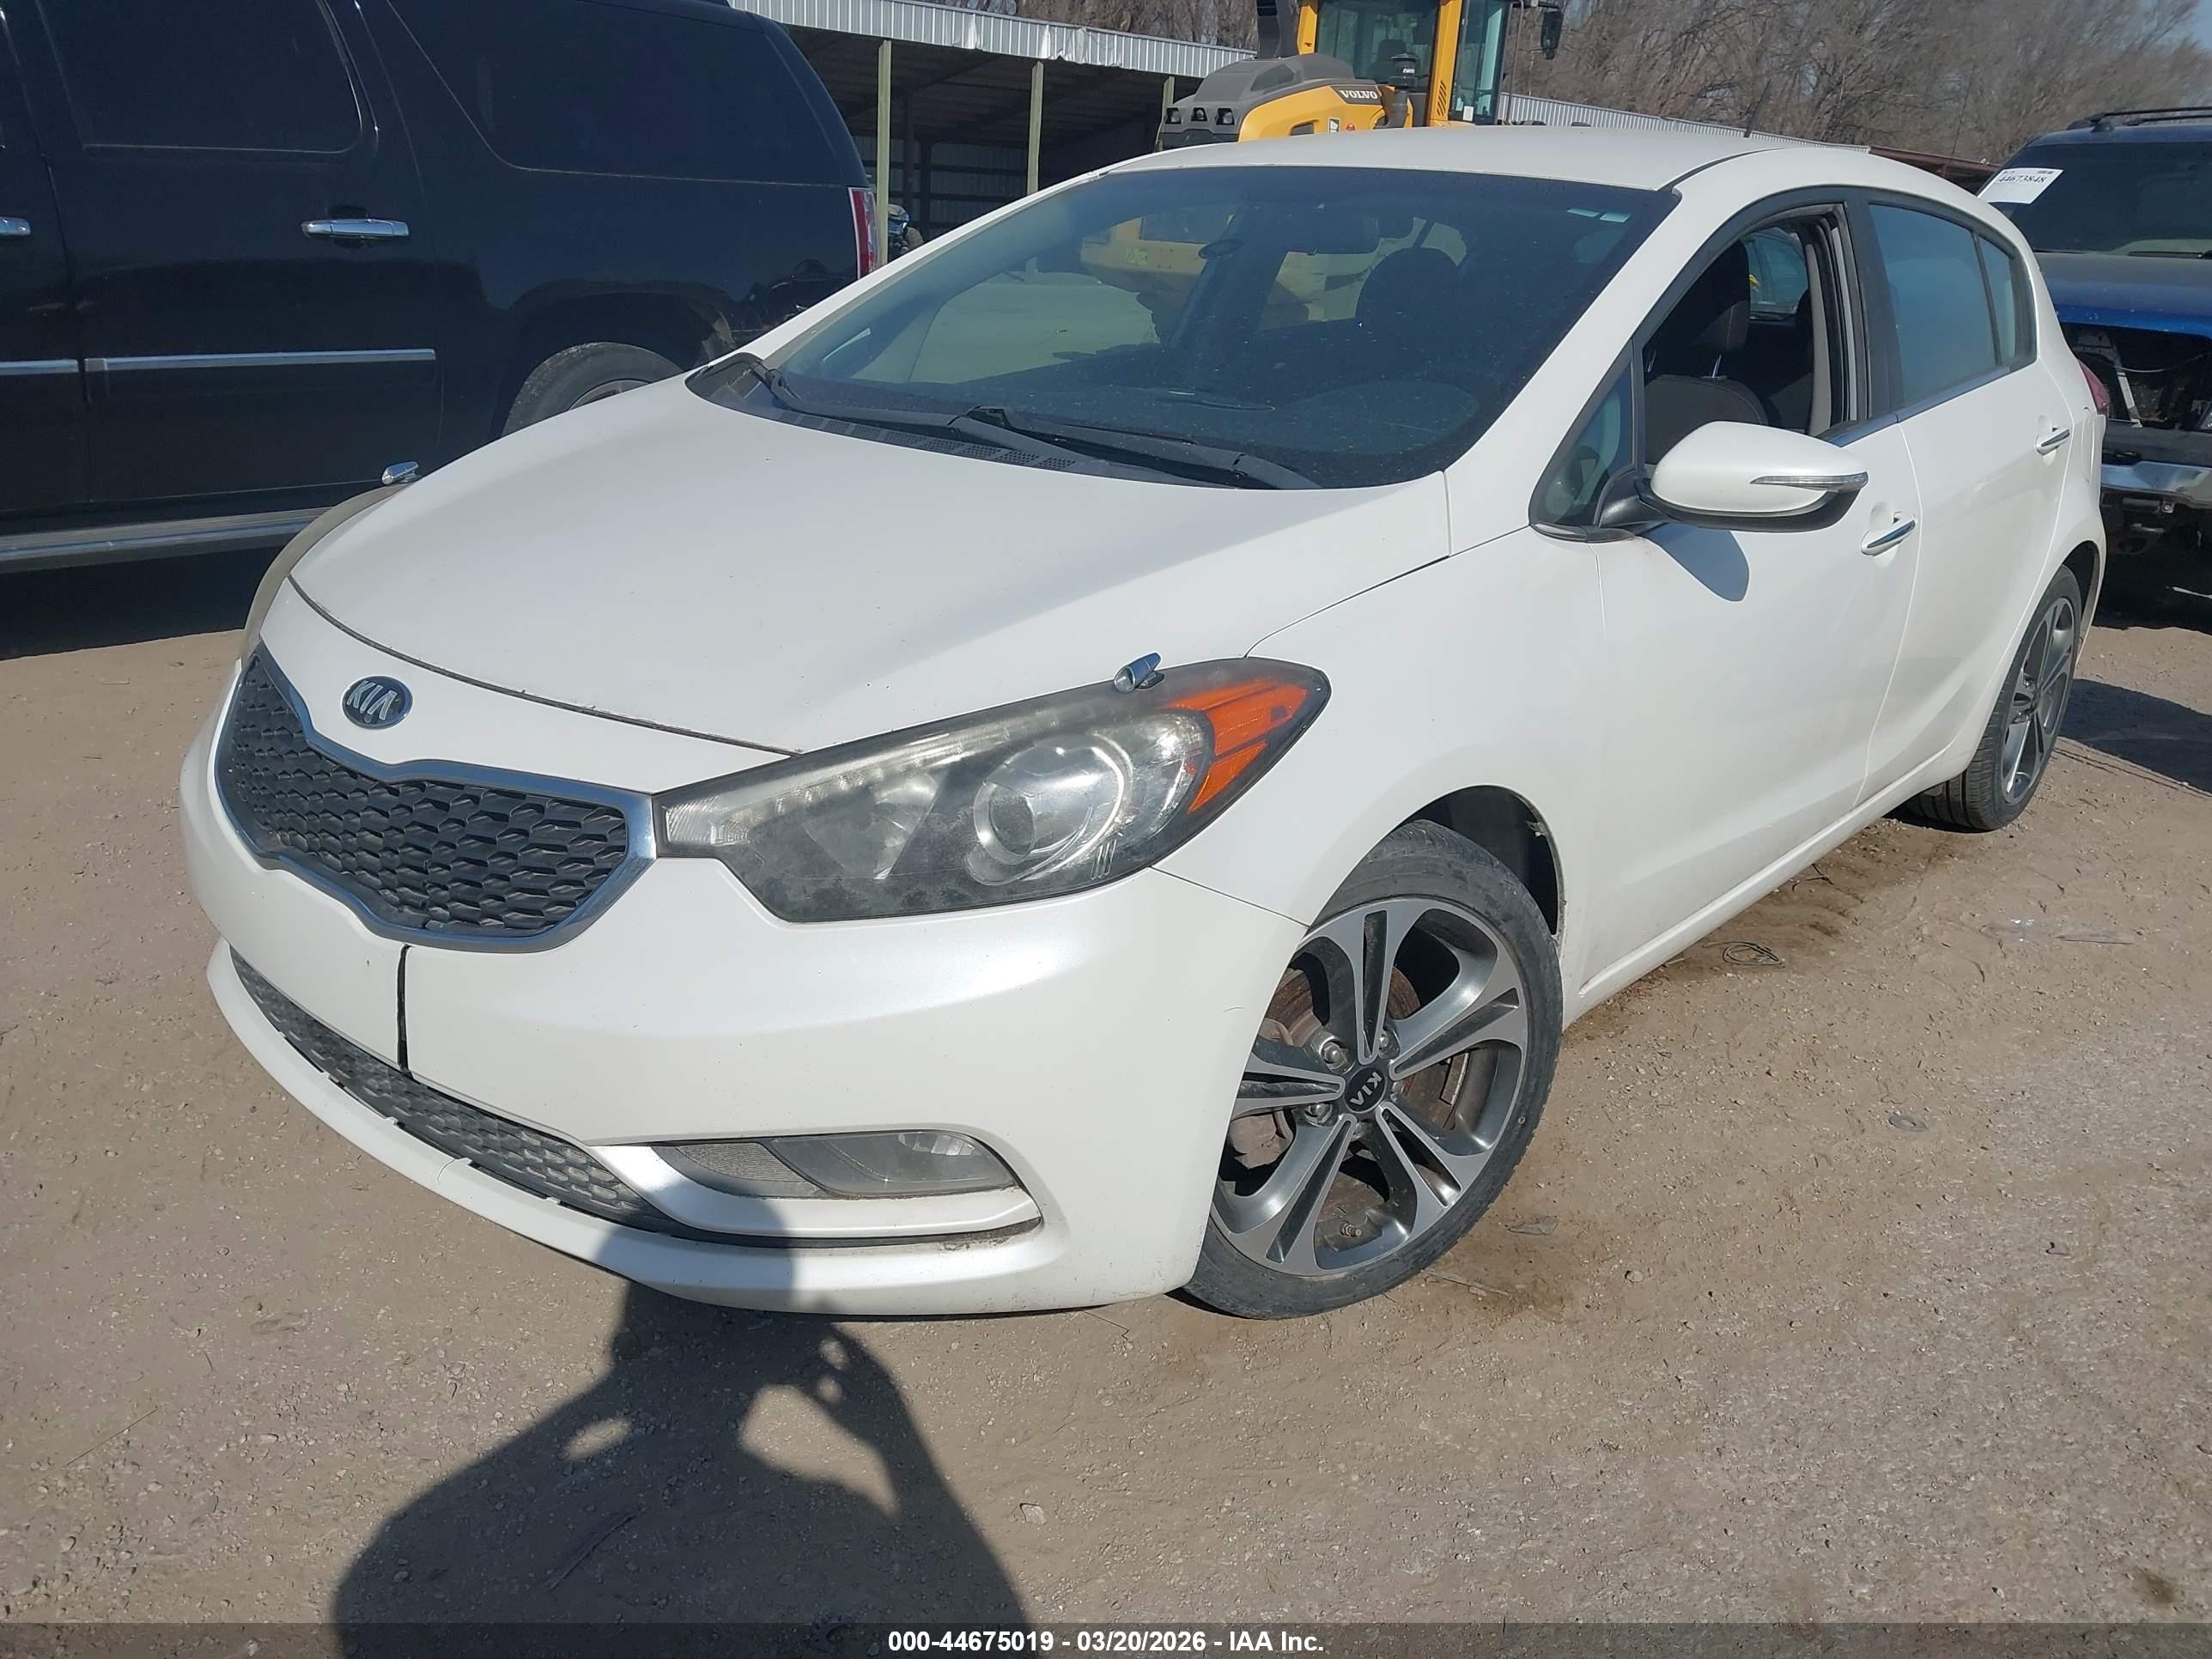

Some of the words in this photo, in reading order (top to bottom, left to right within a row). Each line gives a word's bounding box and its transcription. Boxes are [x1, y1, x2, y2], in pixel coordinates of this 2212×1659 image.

[1339, 89, 1378, 100] VOLVO
[1998, 174, 2048, 184] 44673848
[346, 680, 398, 720] KIA
[1349, 1071, 1383, 1106] KIA
